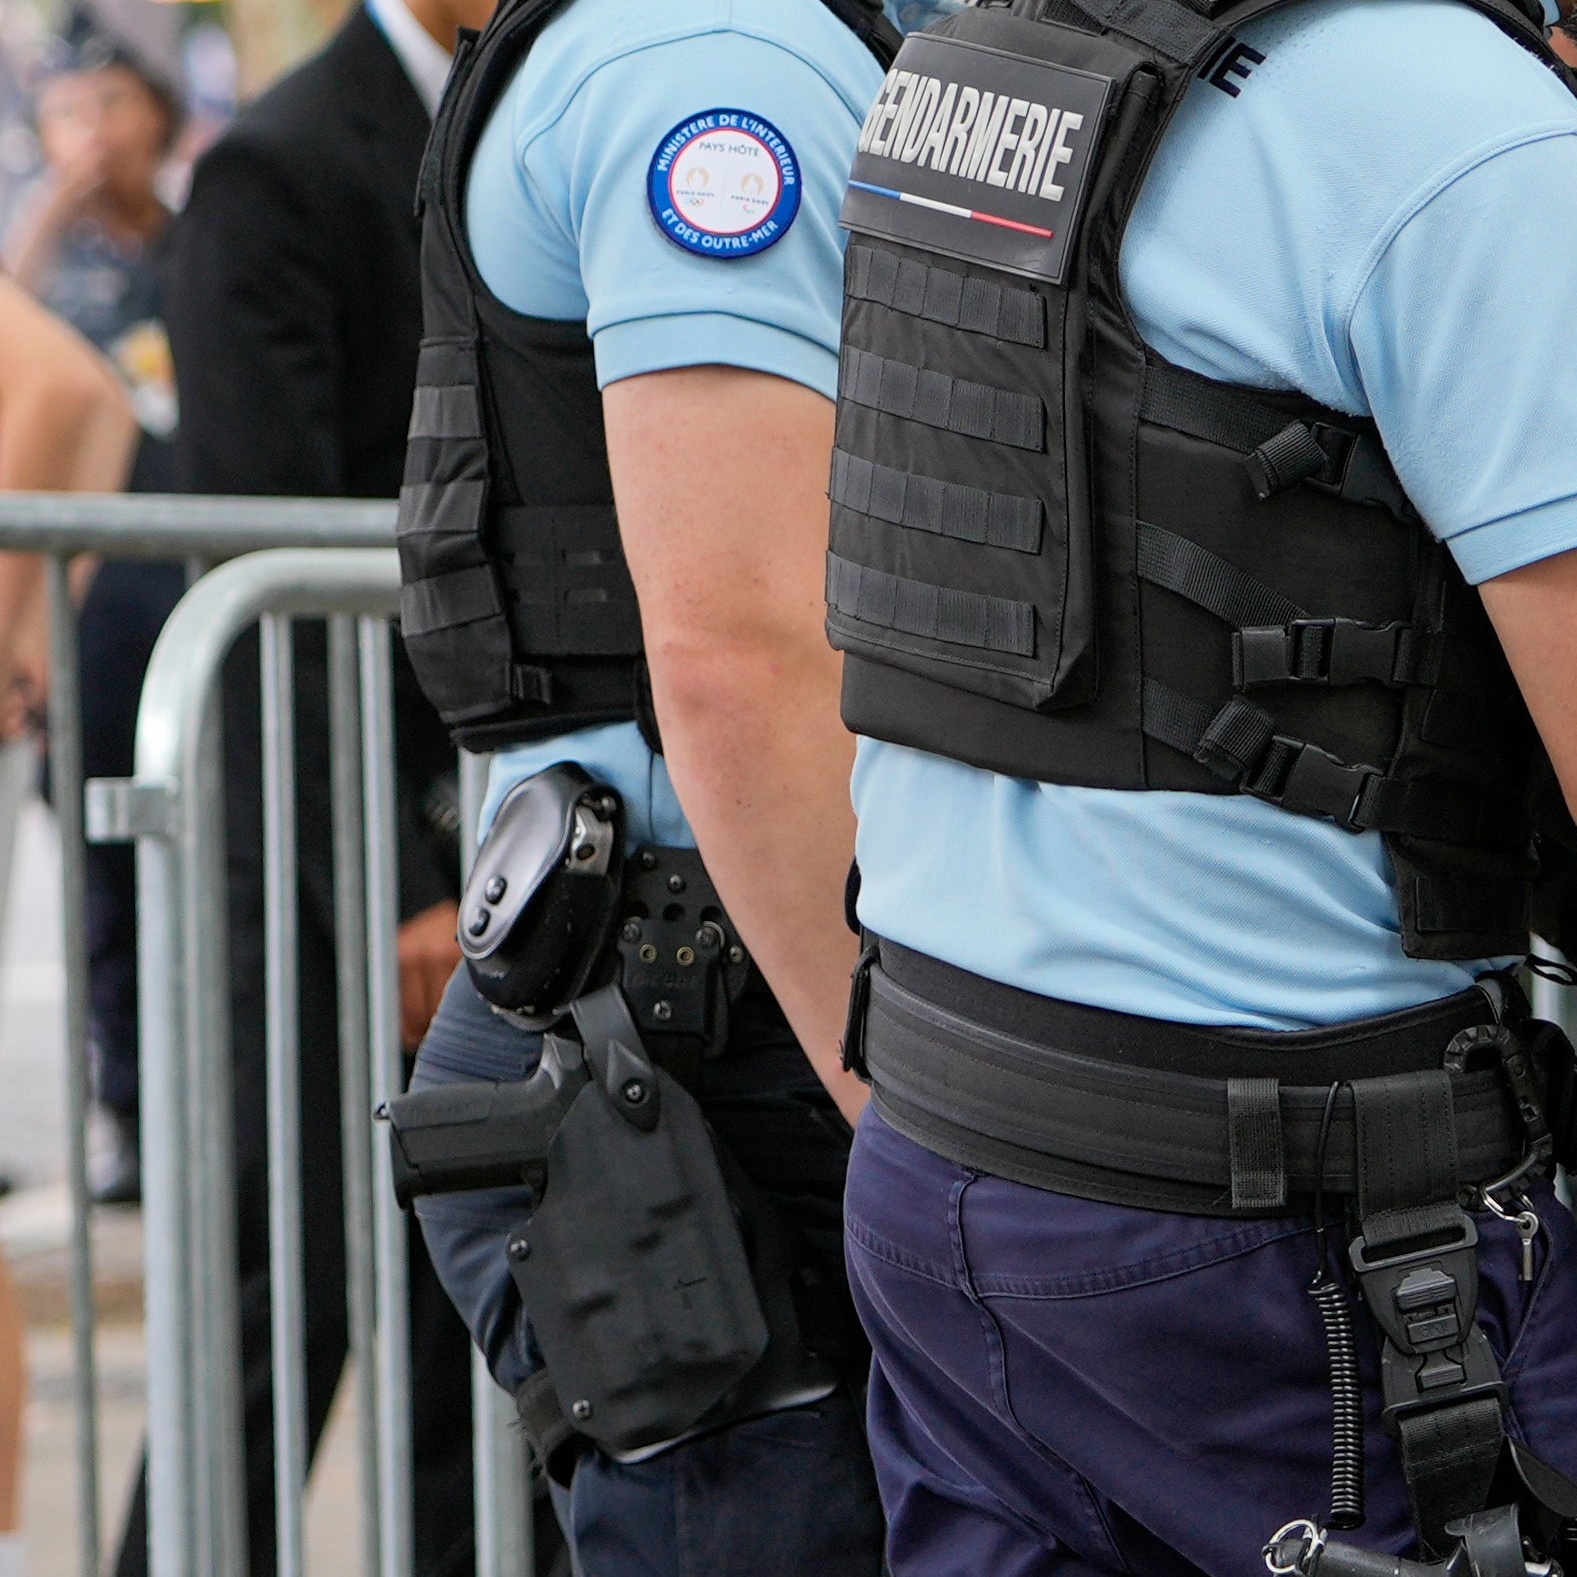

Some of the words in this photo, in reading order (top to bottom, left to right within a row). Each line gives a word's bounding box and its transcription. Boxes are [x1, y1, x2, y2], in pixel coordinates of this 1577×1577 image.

[719, 113, 739, 127] DE
[699, 142, 725, 153] PAYS
[857, 68, 1084, 202] GENDARMERIE
[662, 208, 677, 225] ET
[674, 222, 700, 244] DES
[701, 220, 779, 250] OUTRE-MER
